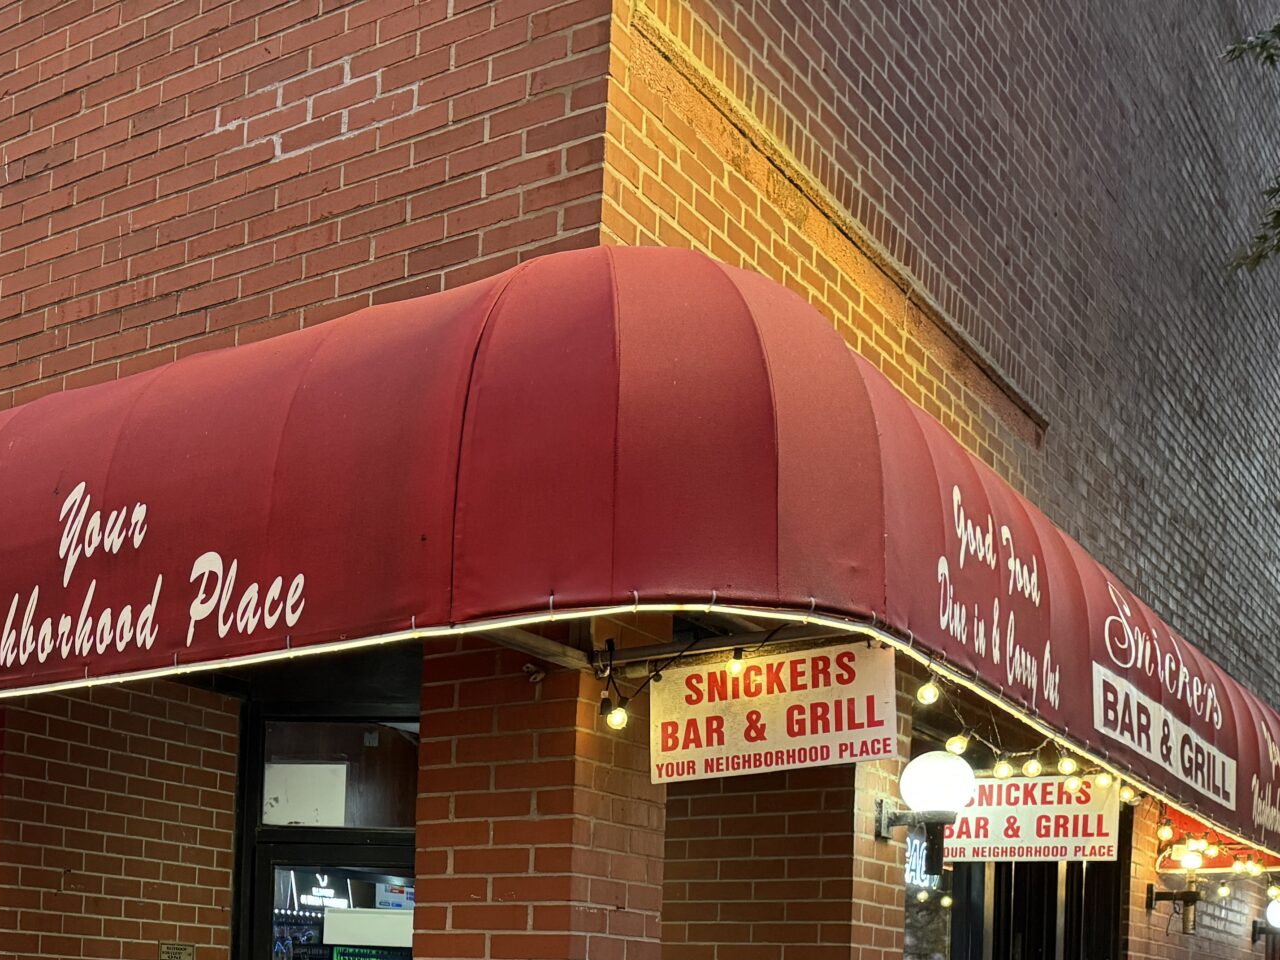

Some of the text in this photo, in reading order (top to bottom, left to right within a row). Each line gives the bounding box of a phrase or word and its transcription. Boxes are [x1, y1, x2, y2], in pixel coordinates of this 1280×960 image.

[58, 481, 148, 588] Your
[952, 485, 1040, 607] Good Food
[186, 551, 305, 648] Place
[937, 556, 1060, 710] Dine in & Carry Out
[684, 651, 856, 706] SNICKERS
[1104, 581, 1222, 730] Snickers
[656, 737, 892, 779] YOUR NEIGHBORHOOD PLACE
[660, 695, 885, 752] BAR & GRILL
[1102, 677, 1230, 803] BAR & GRILL
[943, 845, 1114, 858] OUR NEIGHBORHOOD PLACE
[1003, 816, 1020, 838] &
[1036, 814, 1109, 838] GRILL
